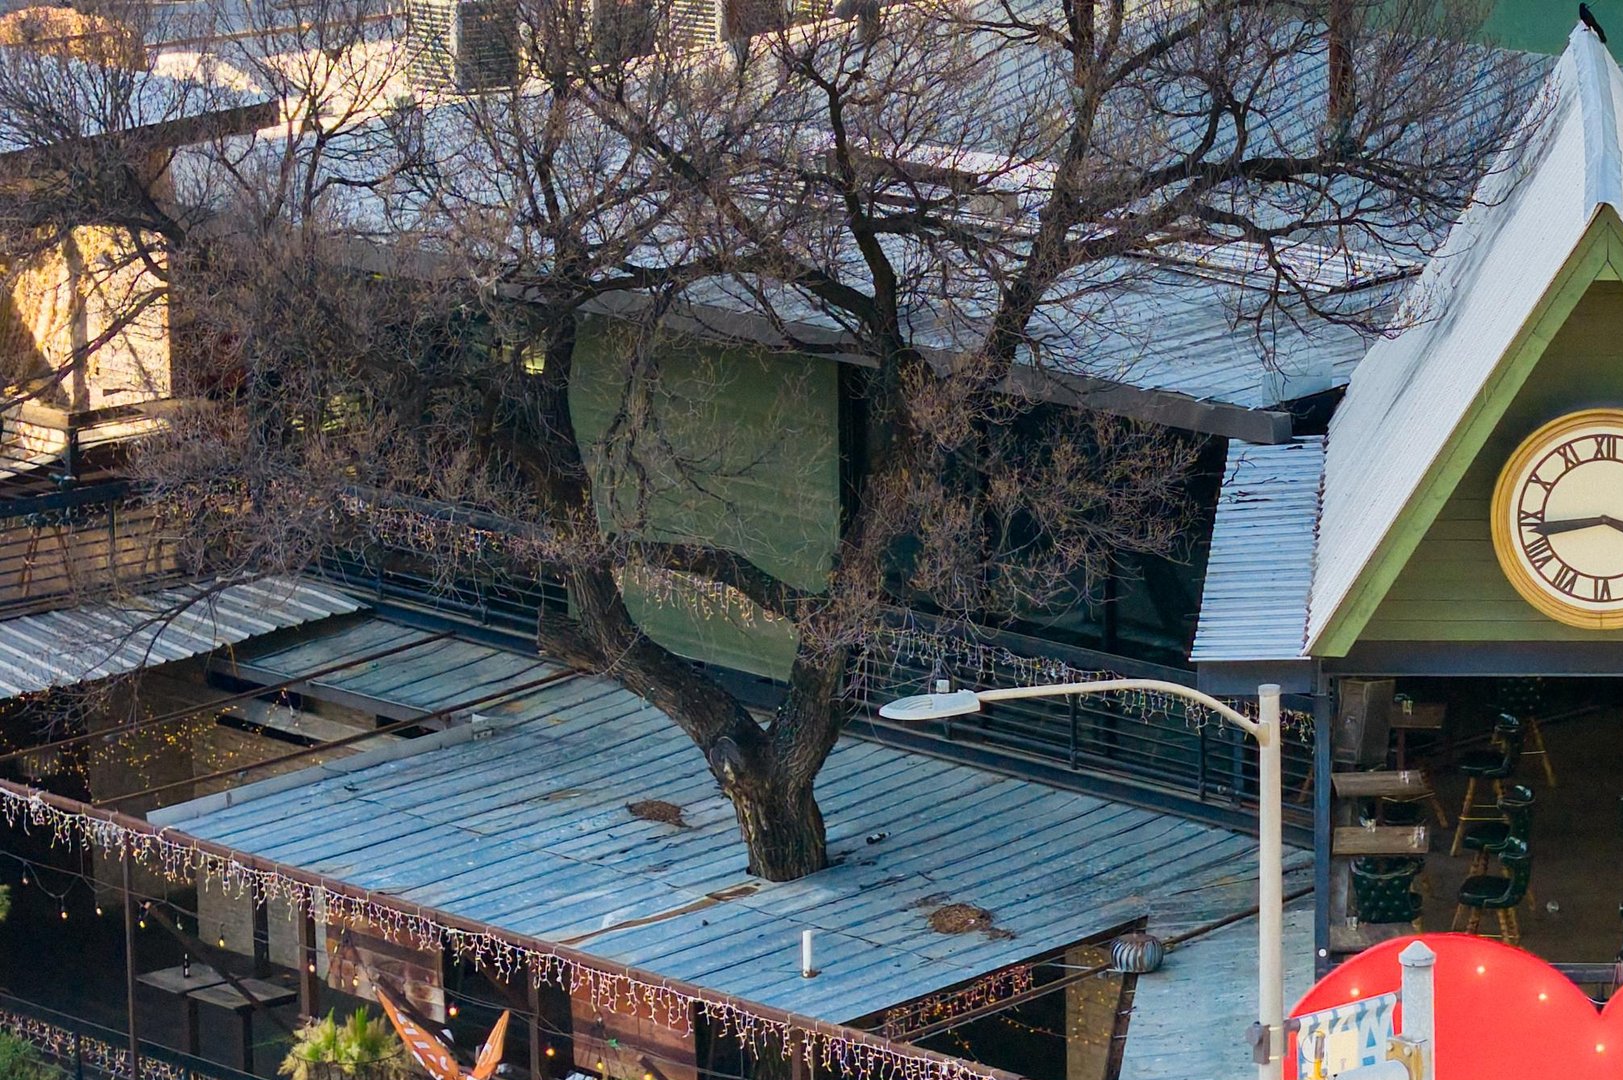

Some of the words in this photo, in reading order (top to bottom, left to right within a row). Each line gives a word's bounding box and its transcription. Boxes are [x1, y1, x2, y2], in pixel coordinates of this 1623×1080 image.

[1556, 442, 1581, 471] XI
[1594, 436, 1616, 460] XII
[1528, 472, 1553, 492] X
[1553, 563, 1579, 596] VII
[1594, 577, 1612, 600] VI
